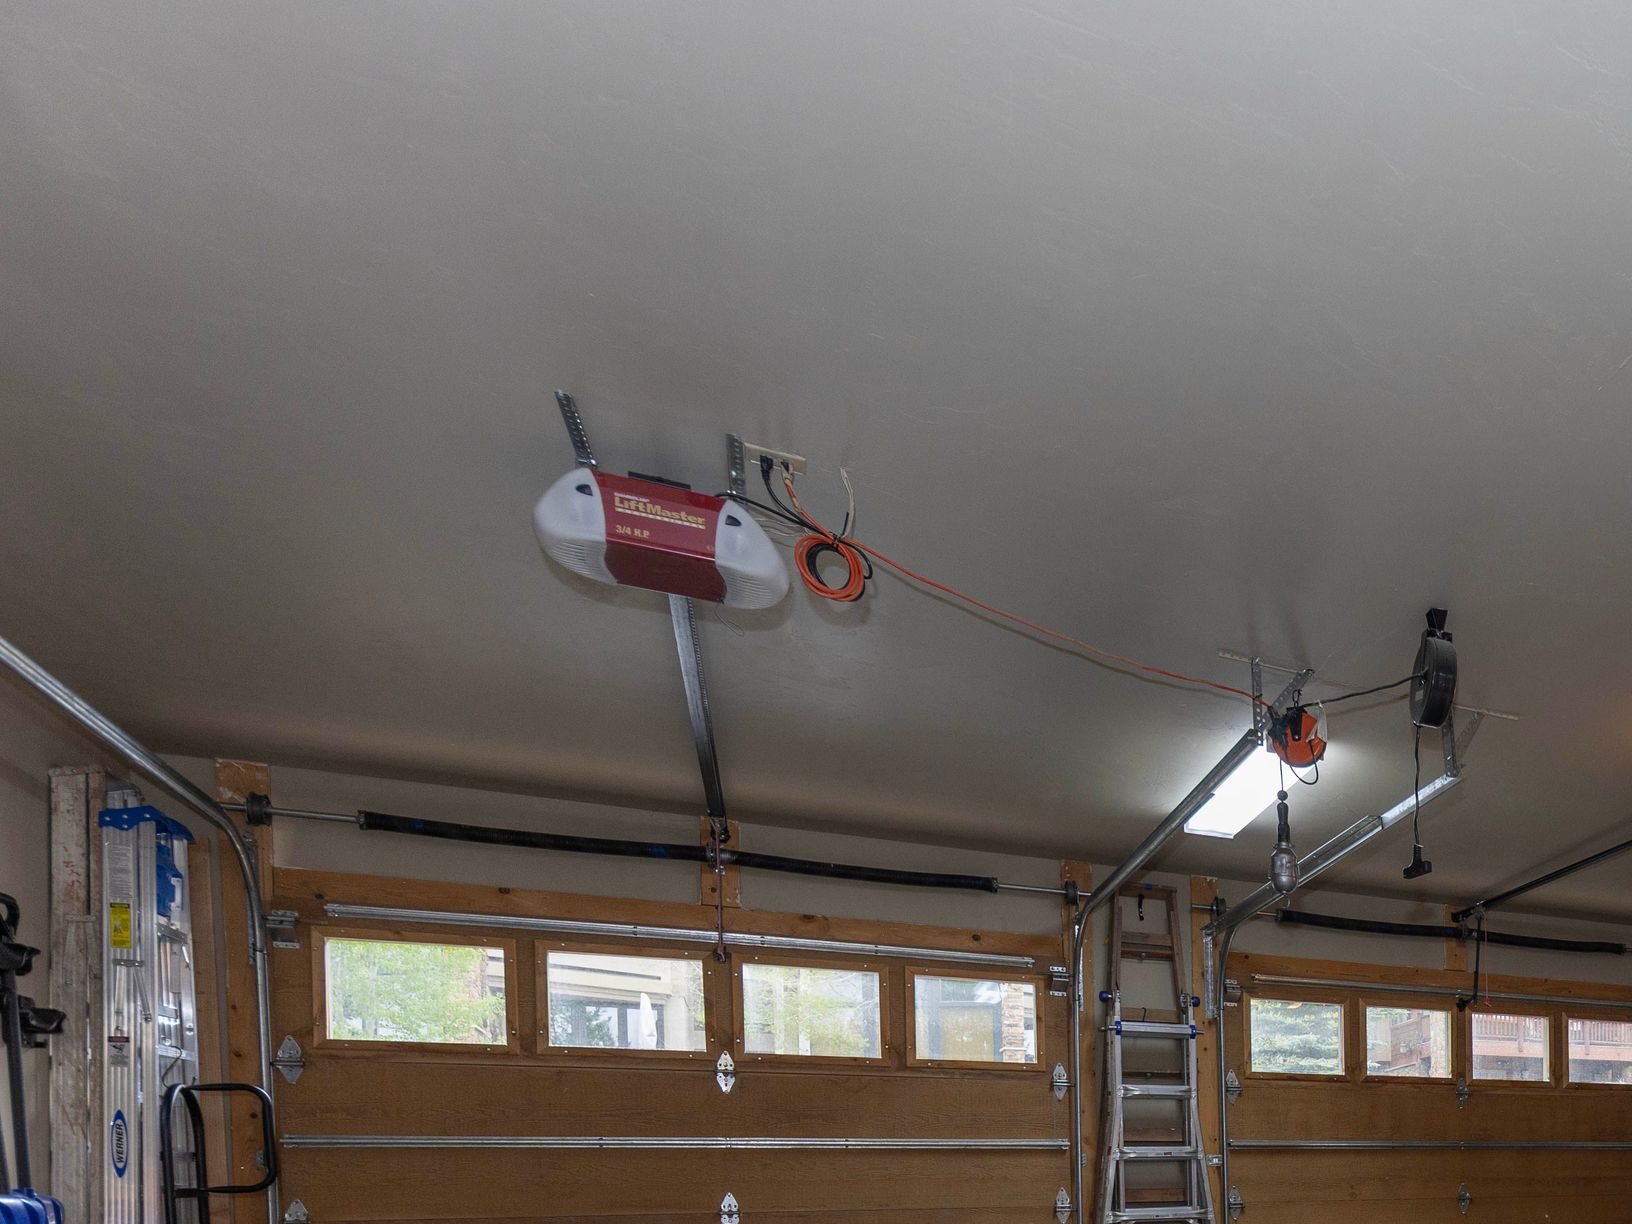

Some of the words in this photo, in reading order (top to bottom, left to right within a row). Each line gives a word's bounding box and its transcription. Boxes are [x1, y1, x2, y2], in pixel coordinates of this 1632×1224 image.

[614, 496, 705, 523] LiftMaster
[615, 524, 632, 536] 3/4
[115, 1123, 125, 1163] WERNER
